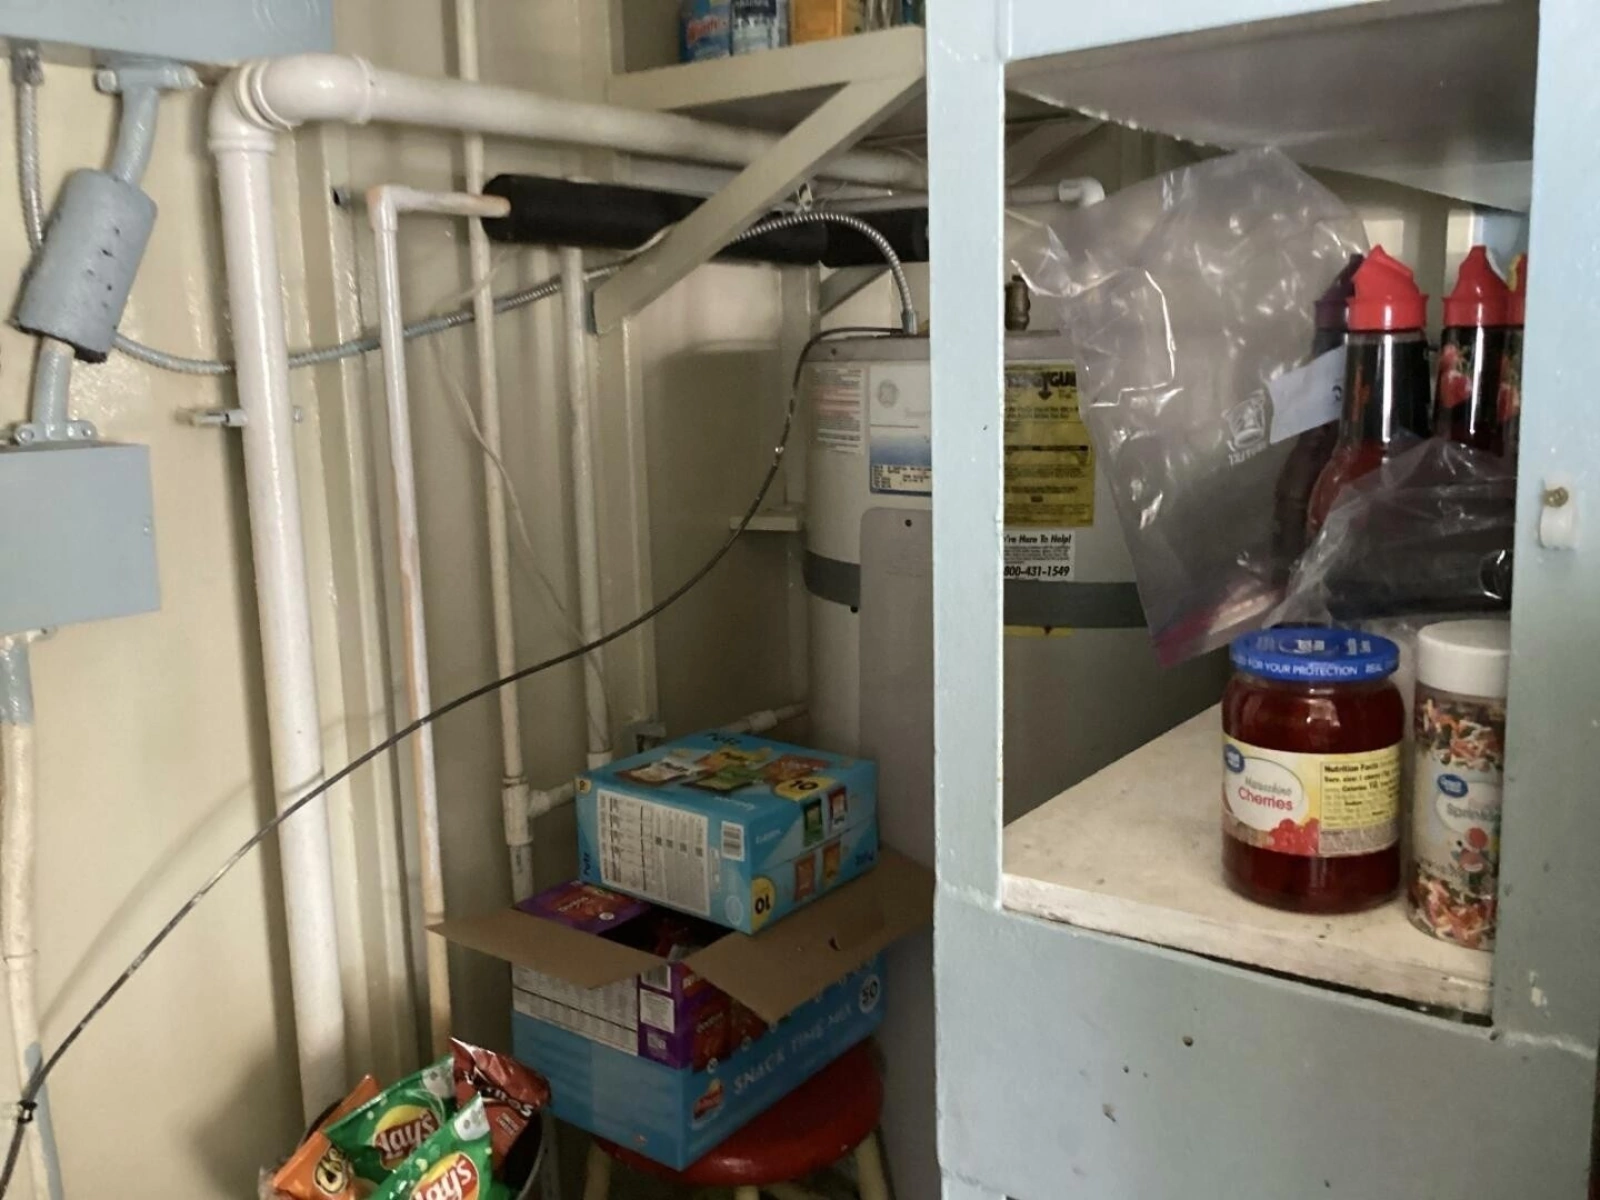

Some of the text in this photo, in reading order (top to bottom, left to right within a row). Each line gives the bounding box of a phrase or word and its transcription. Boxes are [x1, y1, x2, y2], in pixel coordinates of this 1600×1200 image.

[1019, 534, 1038, 544] Here
[1040, 534, 1049, 544] To
[1051, 534, 1072, 545] Help!
[1004, 566, 1071, 577] 800-431-1549
[1247, 659, 1264, 670] FOR
[1265, 661, 1291, 674] YOUR
[1292, 663, 1358, 677] PROTECTION
[1323, 763, 1379, 773] Nutrition Facts
[789, 779, 820, 791] 10
[1237, 786, 1294, 811] Cherries
[754, 893, 771, 915] 10
[861, 980, 879, 1006] 50
[733, 1002, 854, 1095] SNACK TIME MIX
[376, 1109, 437, 1161] Lay's
